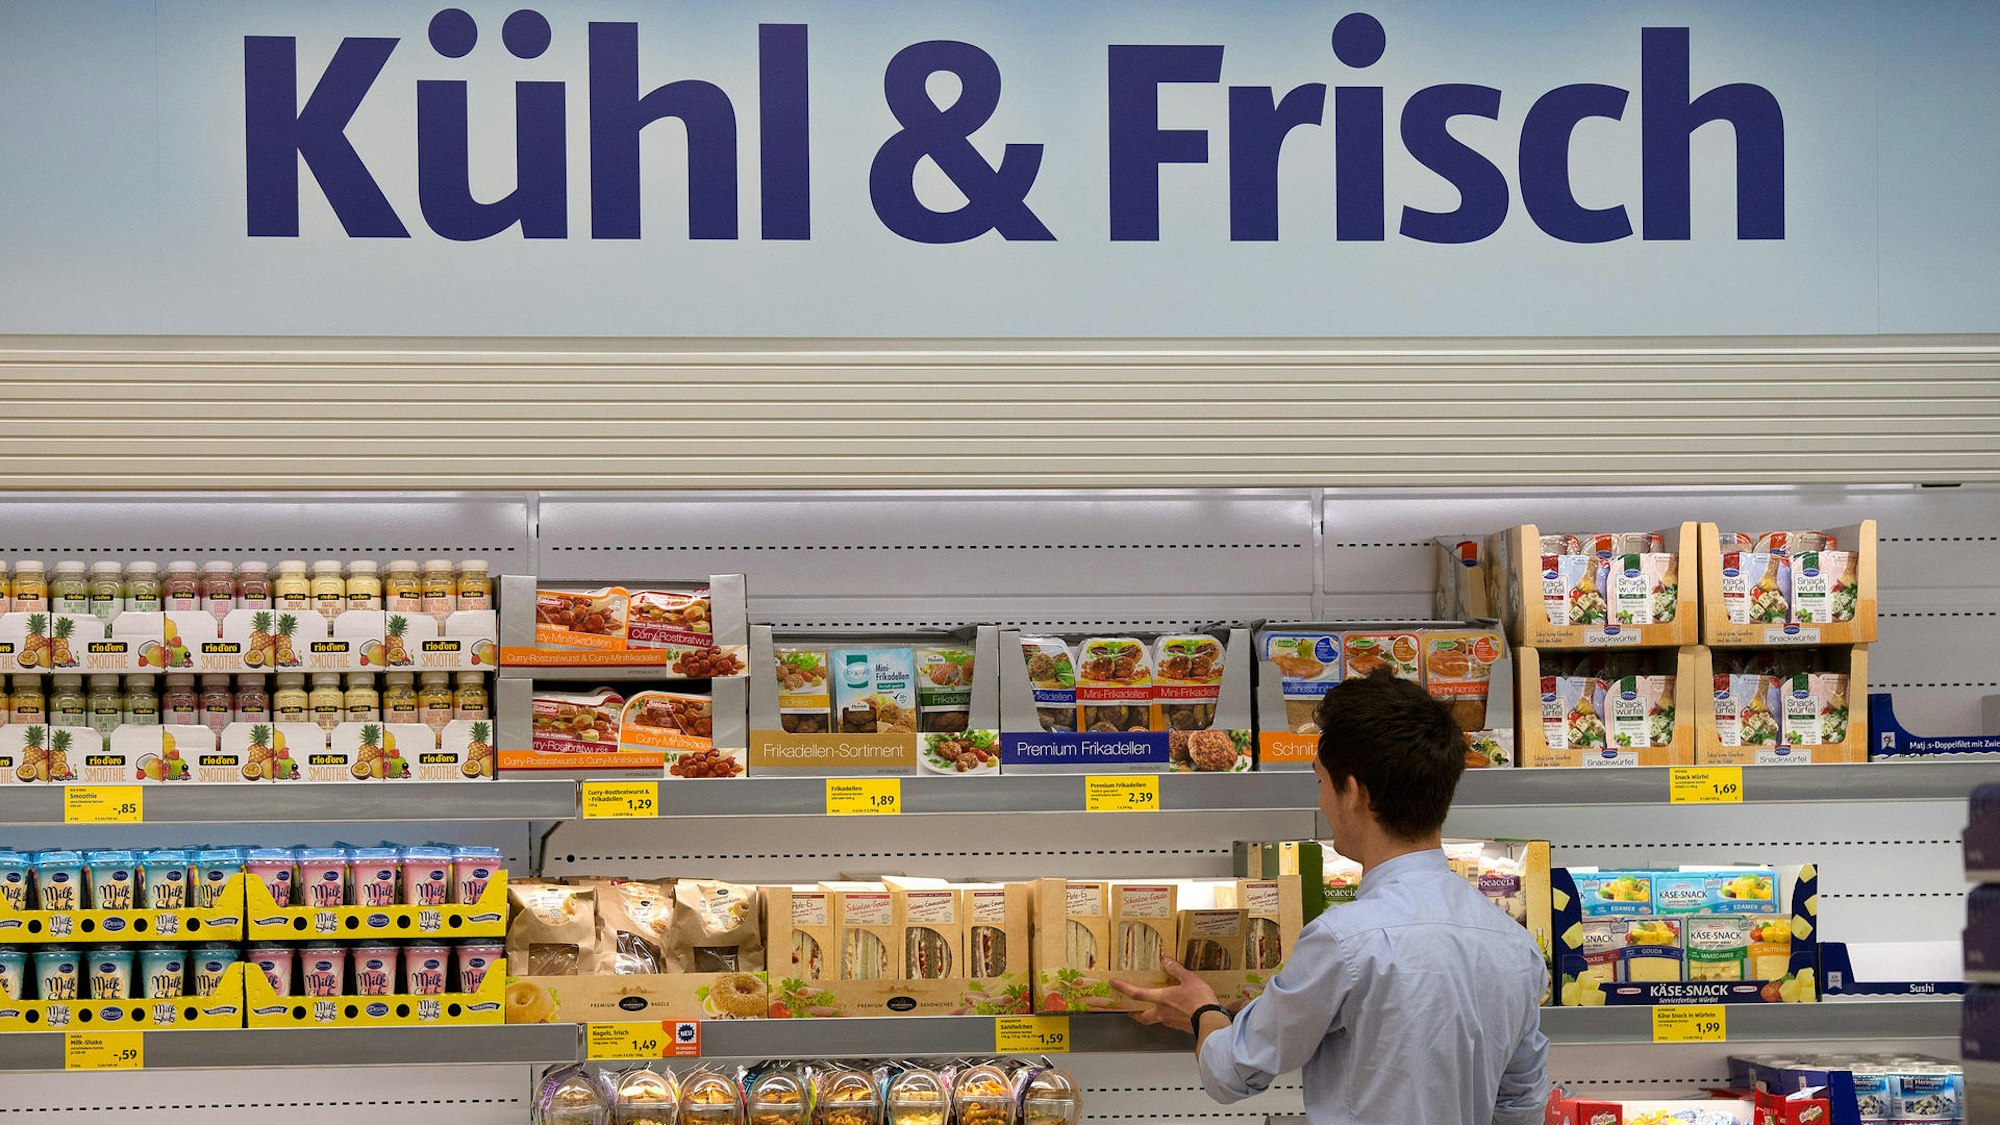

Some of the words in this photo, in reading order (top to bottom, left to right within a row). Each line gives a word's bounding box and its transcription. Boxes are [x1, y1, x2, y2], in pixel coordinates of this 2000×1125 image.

[244, 8, 811, 242] Kühl
[869, 40, 1058, 245] &
[1108, 12, 1786, 245] Frisch
[1590, 635, 1637, 643] Snackwürfel
[87, 655, 128, 669] SMOOTHIE
[202, 655, 242, 669] SMOOTHIE
[310, 654, 349, 669] SMOOTHIE
[421, 653, 461, 667] SMOOTHIE
[507, 654, 580, 664] Curry-Rostbratwurst
[589, 654, 661, 663] Curry-Minifrikadellen
[875, 664, 890, 672] Mini-
[875, 673, 909, 681] Frikadellen
[1083, 689, 1148, 698] Mini-Frikadellen
[763, 744, 904, 758] Frikadellen-Sortiment
[1017, 742, 1077, 756] Premium
[1082, 741, 1151, 755] Frikadellen
[1910, 740, 1970, 750] Matjs-Doppelfilet
[504, 757, 577, 767] Curry-Rostbratwurst
[586, 756, 658, 765] Curry-Minifrikadellen
[84, 768, 125, 782] SMOOTHIE
[200, 768, 239, 782] SMOOTHIE
[309, 767, 348, 781] SMOOTHIE
[419, 766, 458, 780] SMOOTHIE
[1713, 784, 1736, 795] 1,69
[628, 800, 652, 810] 1,29
[870, 796, 894, 806] 1,89
[1129, 793, 1152, 803] 2,39
[113, 804, 136, 814] -,85
[43, 886, 73, 901] Milk
[100, 885, 130, 899] Milk
[153, 884, 183, 899] Milk
[201, 884, 225, 899] Mil
[310, 884, 341, 899] Milk
[363, 884, 393, 899] Milk
[416, 883, 445, 898] Milk
[1660, 890, 1707, 899] KÄSE-SNACK
[1583, 935, 1614, 943] -SNACK
[1691, 931, 1742, 940] KÄSE-SNACK
[45, 977, 75, 992] Milk
[92, 977, 121, 992] Milk
[152, 975, 181, 991] Milk
[305, 974, 335, 990] Milk
[358, 973, 386, 988] Milk
[412, 973, 442, 986] Milk
[1650, 984, 1728, 997] KÄSE-SNACK
[1910, 983, 1934, 993] Sushi
[1696, 1023, 1719, 1034] 1,99
[632, 1040, 657, 1051] 1,49
[1040, 1034, 1063, 1044] 1,59
[113, 1050, 137, 1061] -,59
